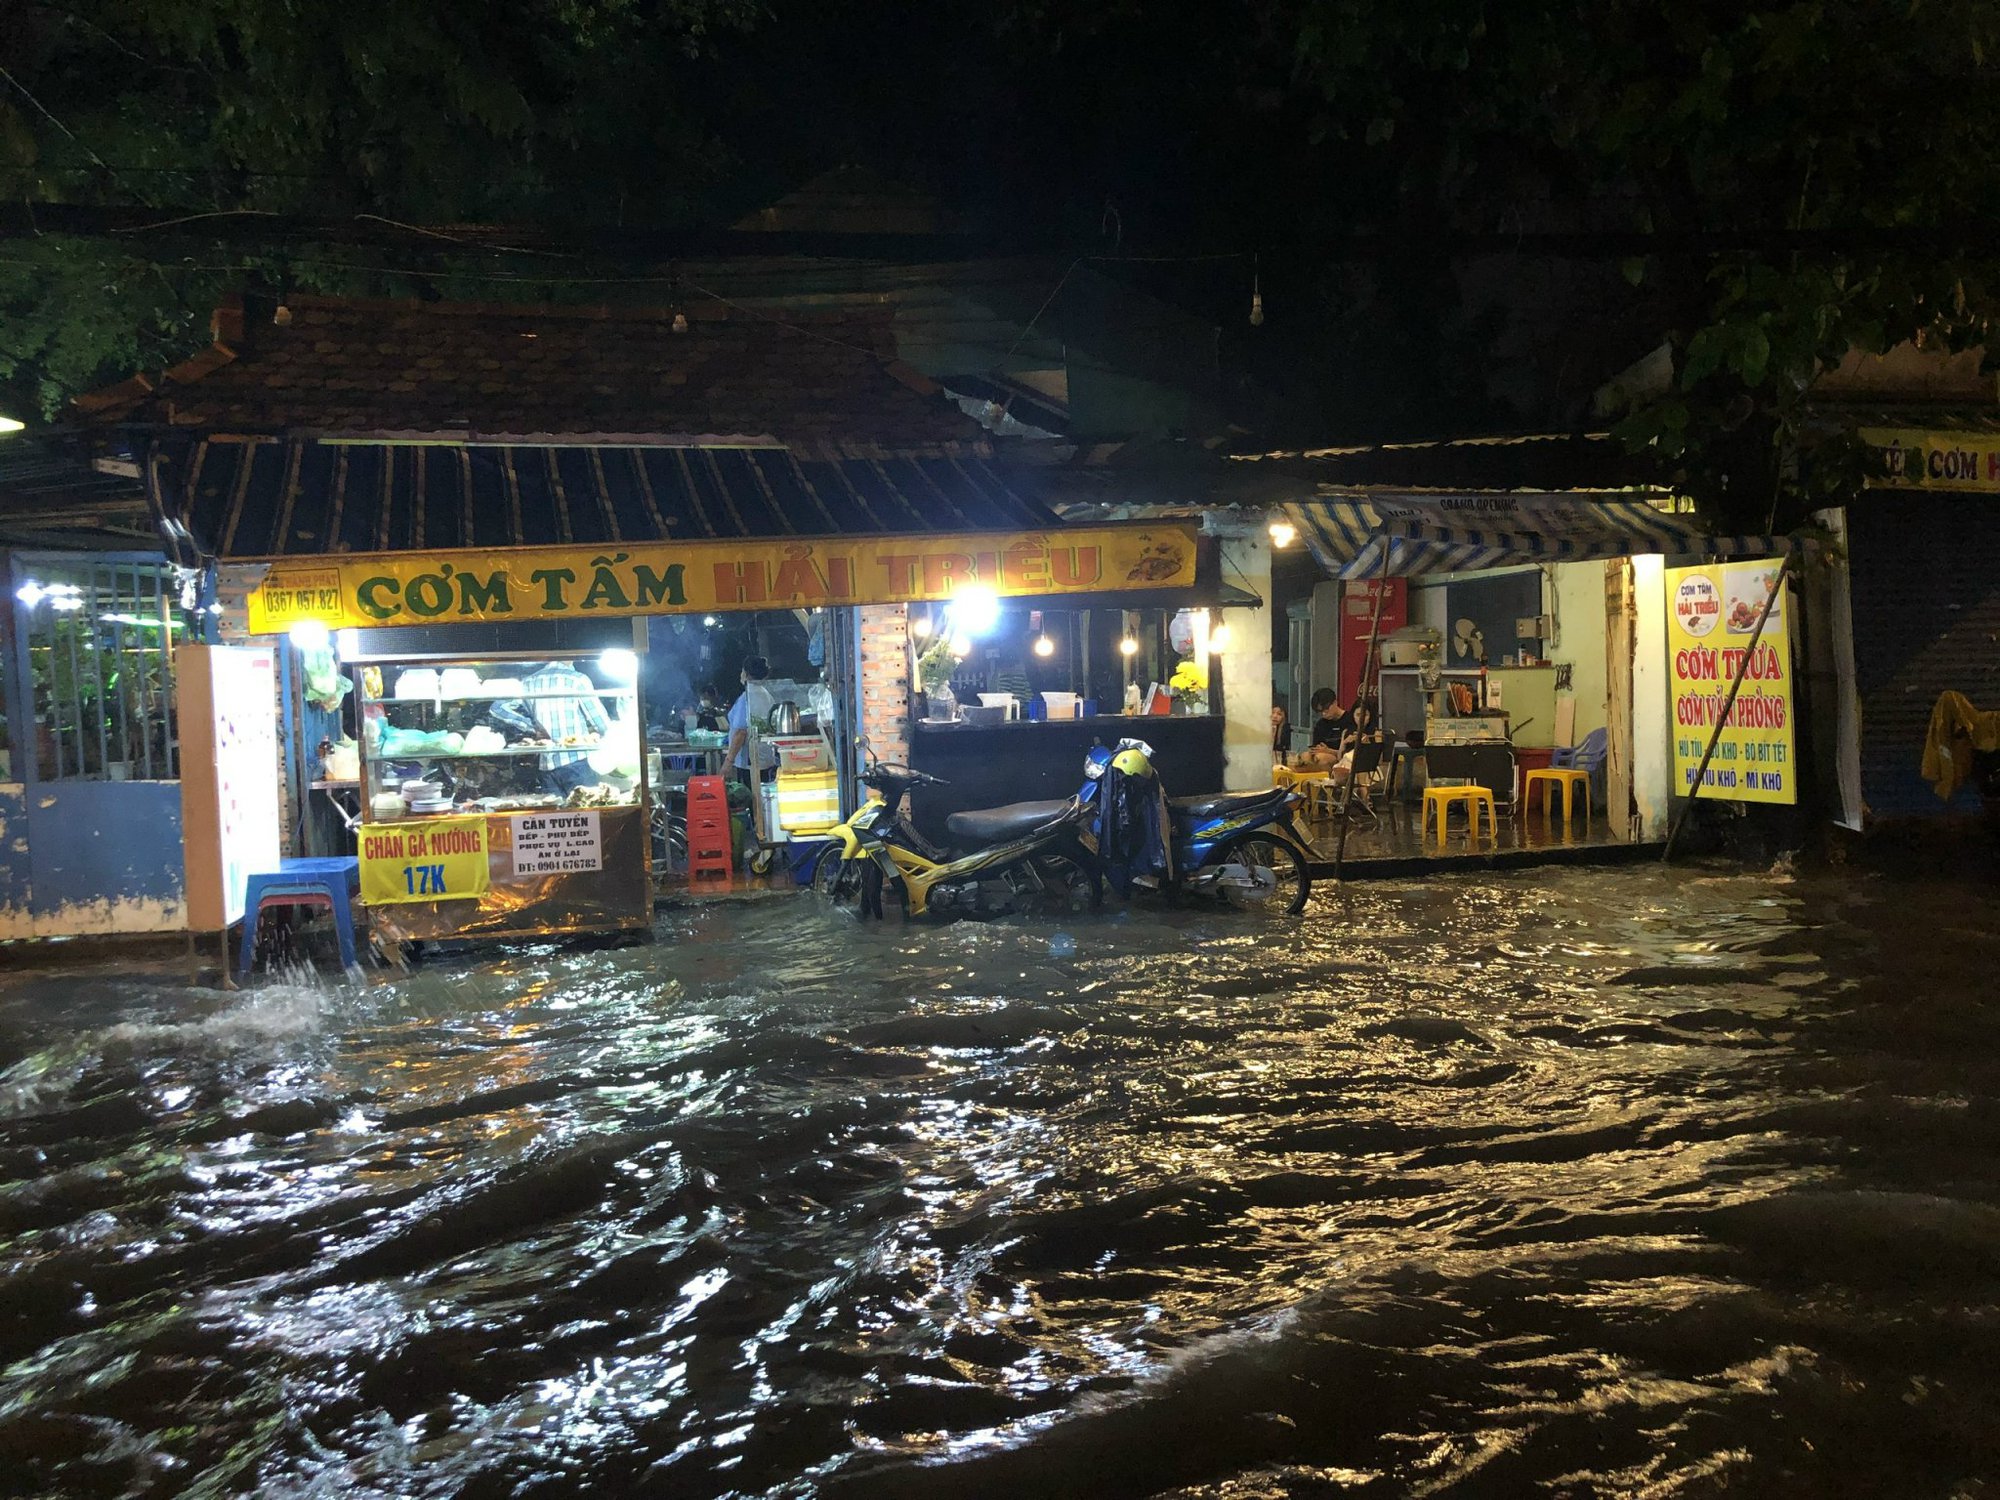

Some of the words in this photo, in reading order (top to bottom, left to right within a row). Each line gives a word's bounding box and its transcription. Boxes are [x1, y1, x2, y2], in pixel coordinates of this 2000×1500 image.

[1928, 446, 1978, 480] CƠM
[357, 563, 513, 620] CƠM
[530, 553, 688, 611] TẤM
[713, 543, 855, 604] HẢI
[876, 535, 1102, 596] TRIỀU
[266, 590, 293, 613] 0367
[1678, 597, 1692, 616] HẢI
[1676, 643, 1719, 681] CƠM
[1721, 641, 1783, 681] TRƯA
[1677, 689, 1705, 726] CƠM
[1737, 686, 1786, 729] PHÒNG
[1722, 742, 1737, 760] KHO
[1772, 738, 1787, 763] TẾT
[1717, 767, 1737, 788] KHÔ
[1761, 769, 1782, 791] KHÔ
[522, 816, 546, 830] CẦN
[549, 813, 588, 829] TUYỂN
[364, 832, 404, 860] CHÂN
[408, 829, 428, 858] GÀ
[431, 827, 481, 856] NƯỚNG
[518, 832, 538, 841] BẾP
[547, 832, 567, 840] PHỤ
[570, 829, 590, 838] BẾP
[519, 843, 545, 851] PHỤC
[547, 842, 560, 850] VỤ
[518, 862, 536, 873] ĐT:
[537, 861, 560, 871] 0904
[562, 858, 597, 870] 676782
[403, 864, 447, 895] 17K
